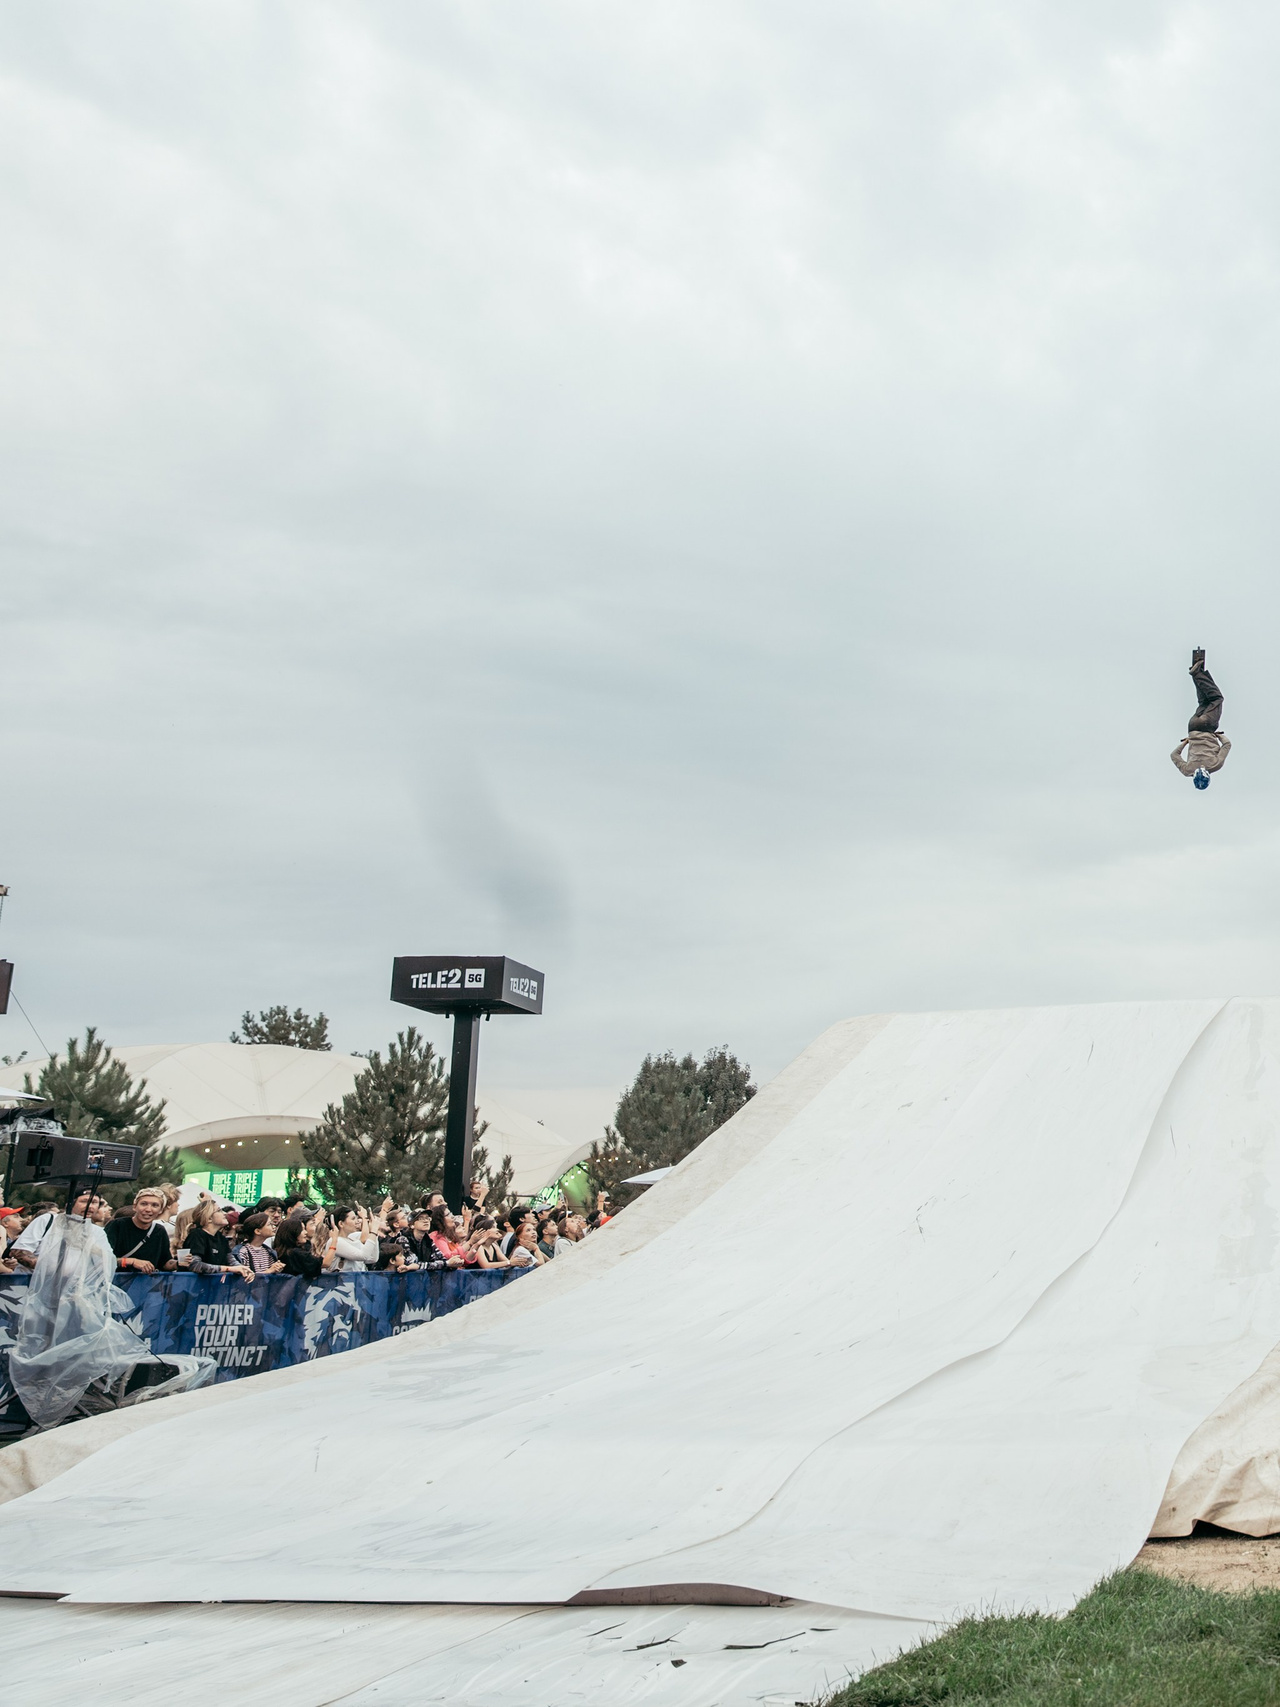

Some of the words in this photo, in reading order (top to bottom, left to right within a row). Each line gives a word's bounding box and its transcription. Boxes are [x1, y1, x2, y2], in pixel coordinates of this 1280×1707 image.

[411, 968, 462, 989] TELE2
[467, 973, 482, 983] 5G
[510, 977, 530, 998] TELE2
[212, 1173, 232, 1184] TRIPLE
[235, 1172, 258, 1183] TRIPLE
[234, 1183, 257, 1194] TRIPLE
[233, 1193, 256, 1204] TRIPLE
[195, 1304, 254, 1325] POWER
[194, 1325, 238, 1347] YOUR
